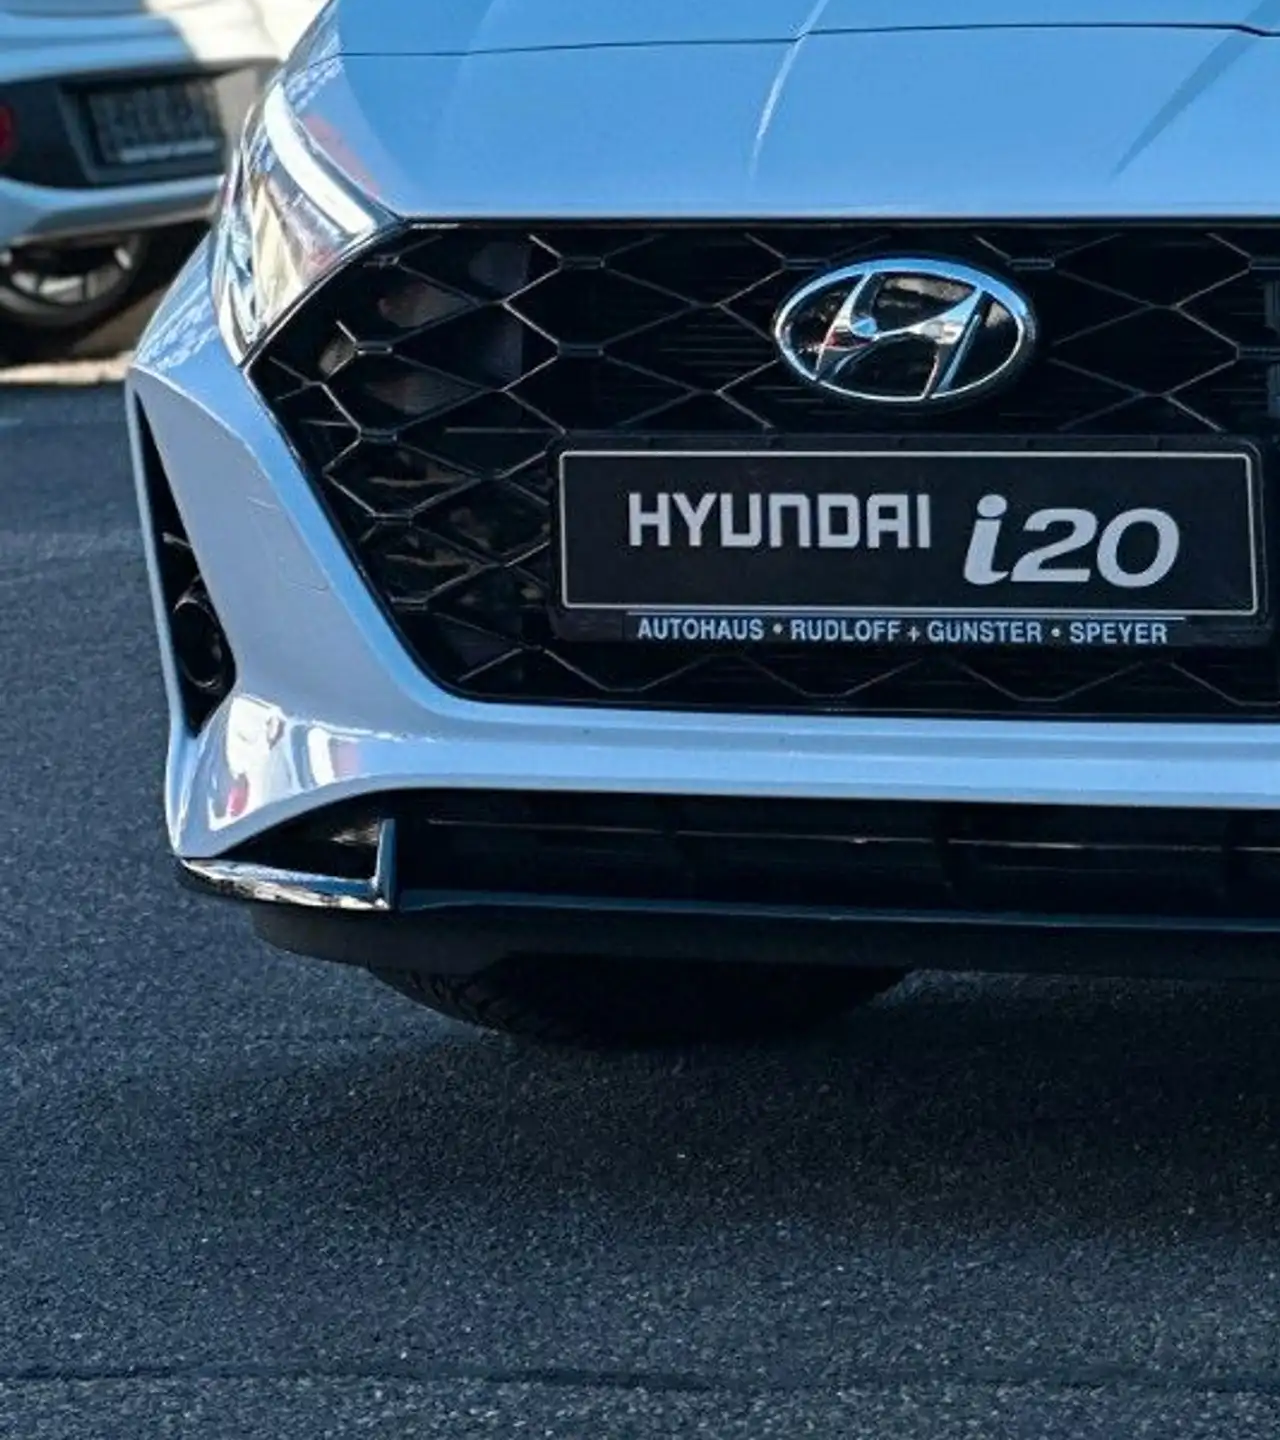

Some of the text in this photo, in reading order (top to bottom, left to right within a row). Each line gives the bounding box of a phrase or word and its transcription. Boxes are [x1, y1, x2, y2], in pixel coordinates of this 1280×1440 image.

[628, 492, 1180, 589] HYUNDAI i20
[636, 617, 765, 641] AUTOHAUS
[790, 619, 901, 642] RUDLOFF
[1068, 621, 1168, 645] SPEYER
